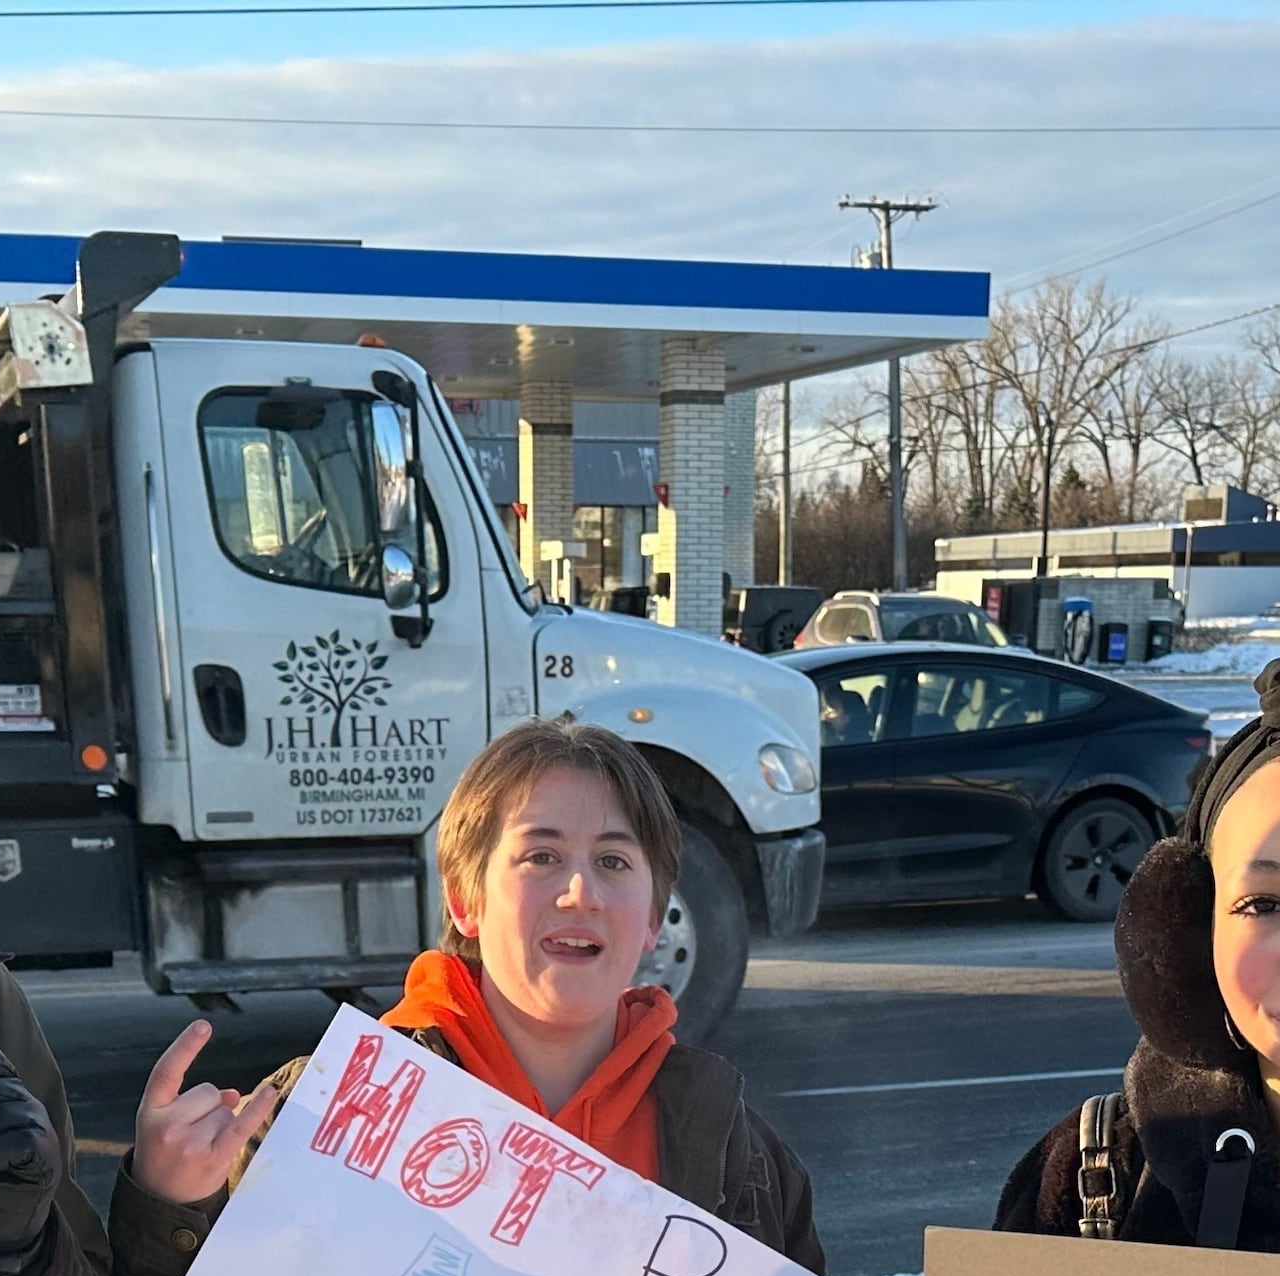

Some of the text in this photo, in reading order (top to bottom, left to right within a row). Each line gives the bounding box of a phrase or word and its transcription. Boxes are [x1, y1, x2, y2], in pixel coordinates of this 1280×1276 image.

[544, 655, 574, 678] 28
[263, 715, 450, 759] J.H. HART
[276, 748, 448, 764] URBAN FORESTRY
[289, 766, 435, 787] 800-404-9390
[299, 787, 426, 804] BIRMINGHAM, MI
[296, 807, 423, 825] US DOT 1737621
[310, 1035, 606, 1246] HOT
